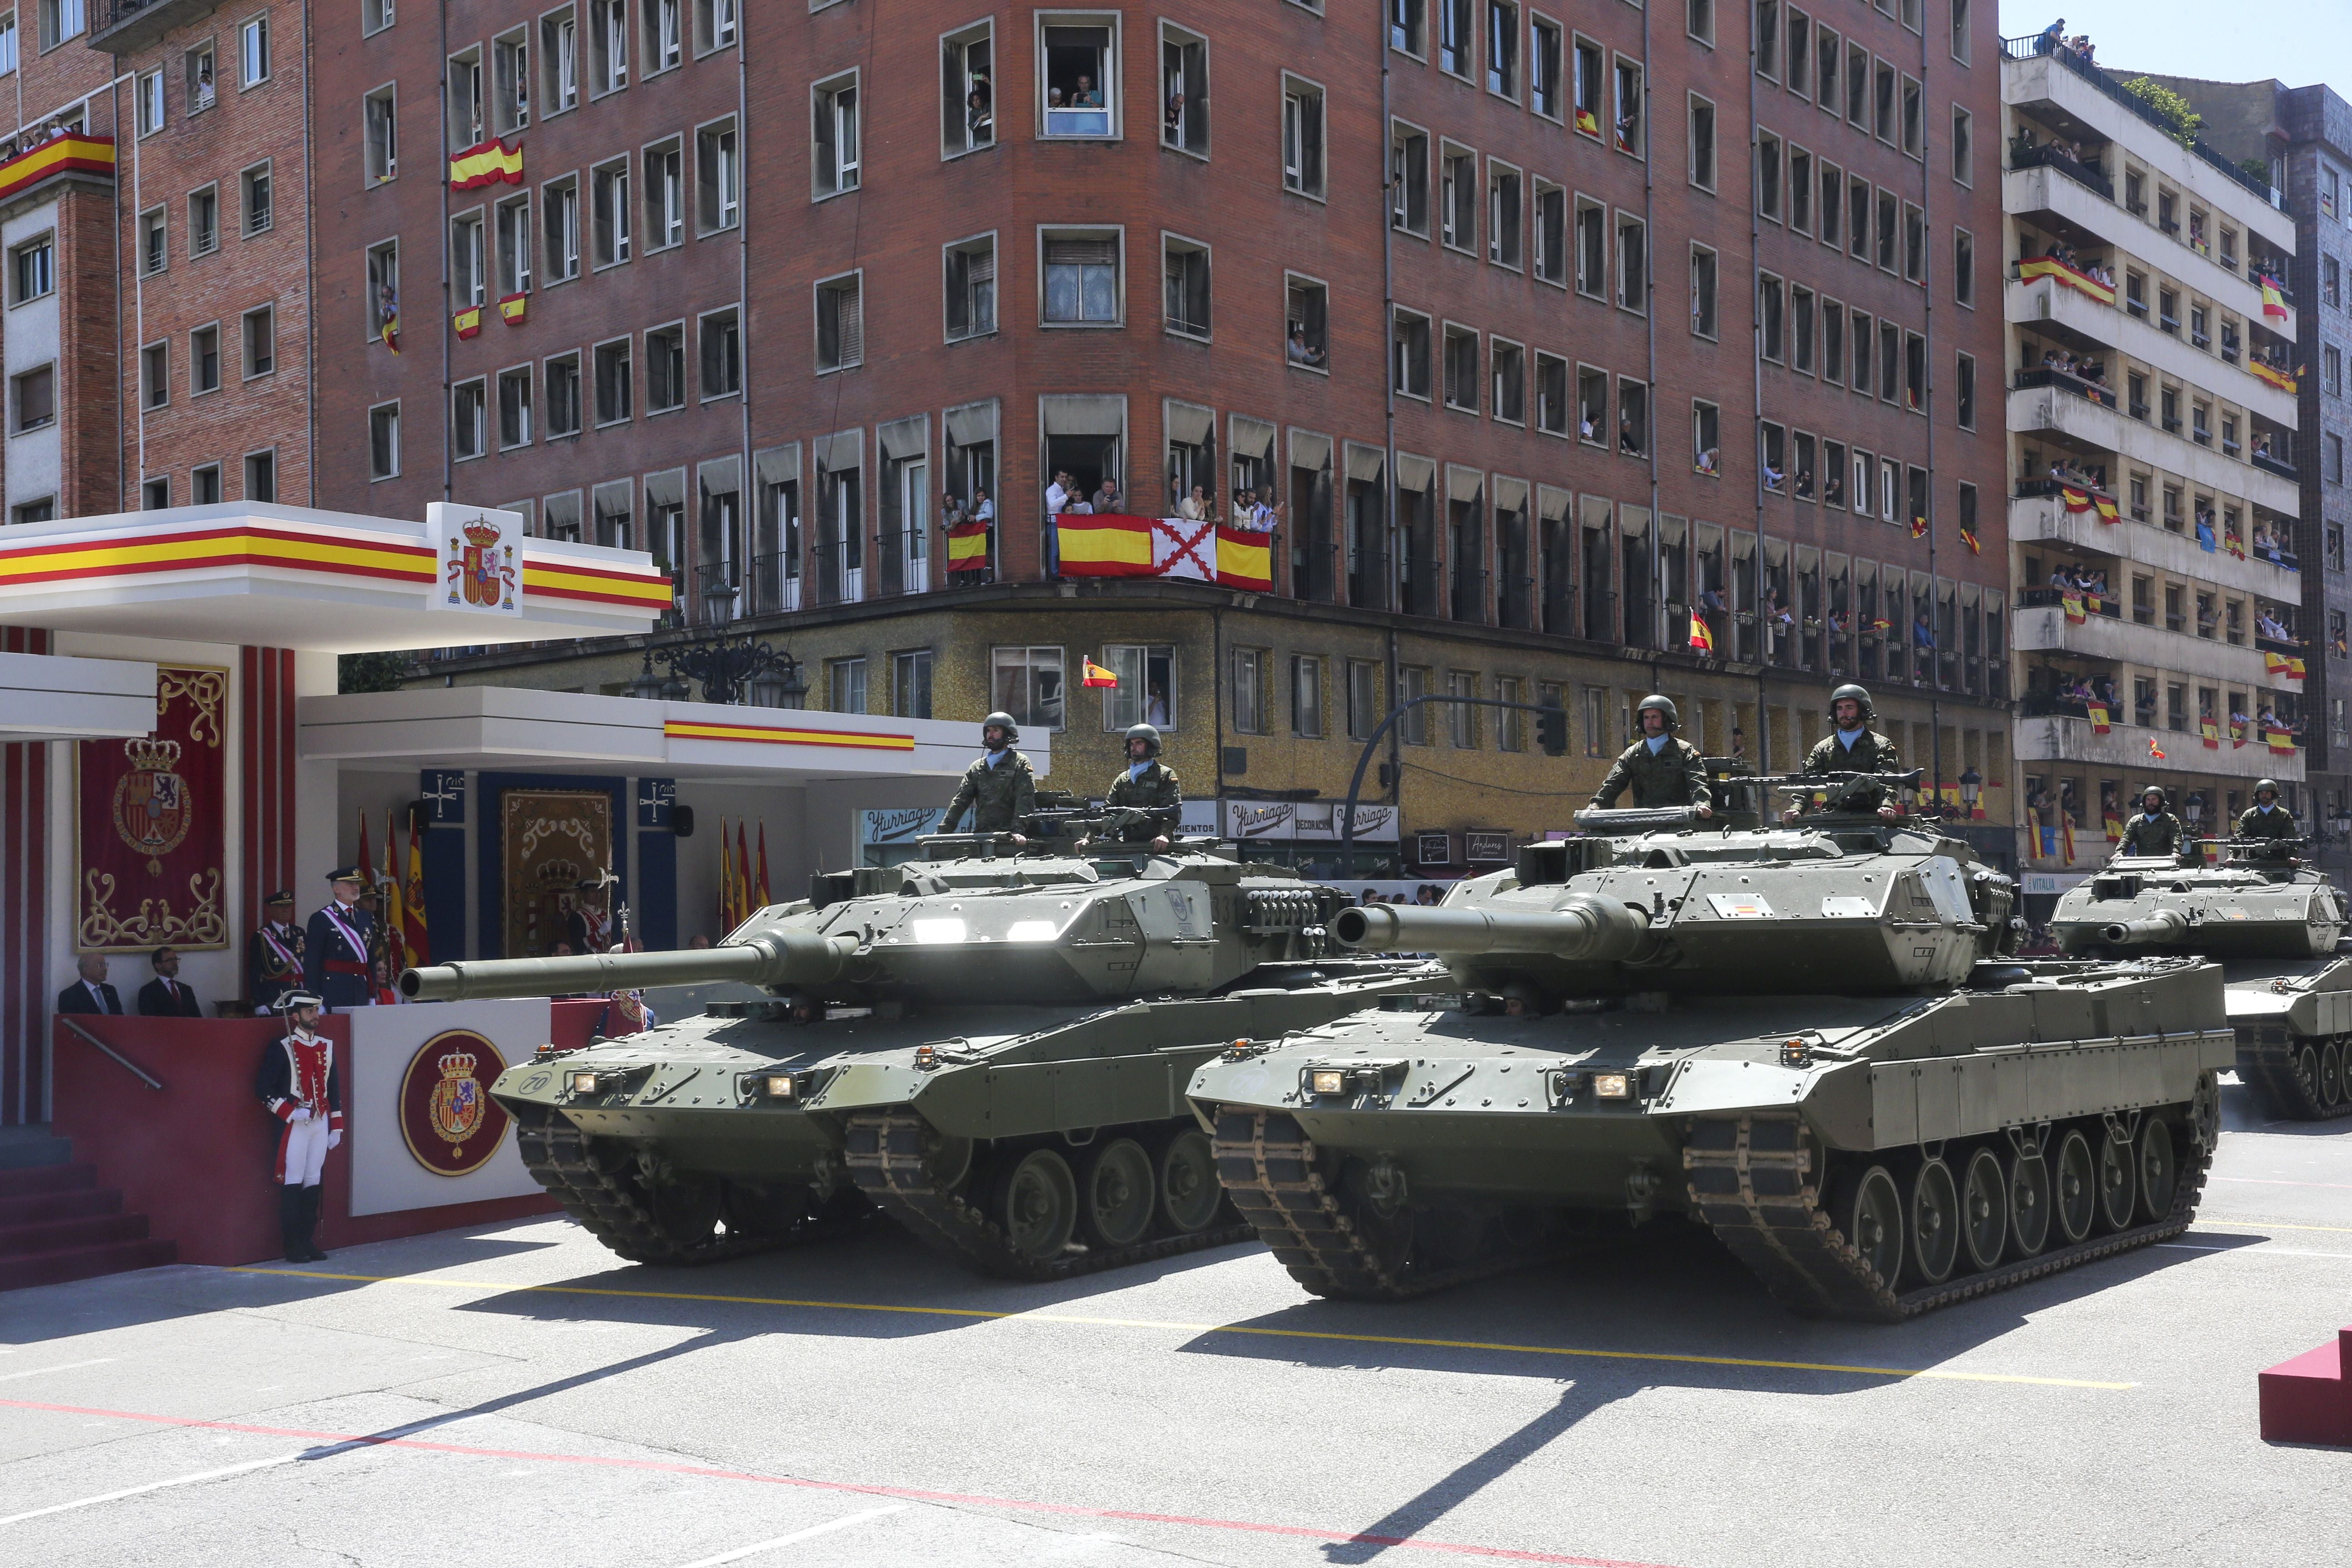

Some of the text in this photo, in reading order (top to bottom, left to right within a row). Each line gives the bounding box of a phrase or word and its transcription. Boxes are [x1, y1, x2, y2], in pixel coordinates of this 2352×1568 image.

[868, 808, 936, 842] Yturriaga
[1233, 804, 1293, 837] Yturriaga
[2032, 878, 2055, 890] VITALIA
[522, 1077, 548, 1090] 70
